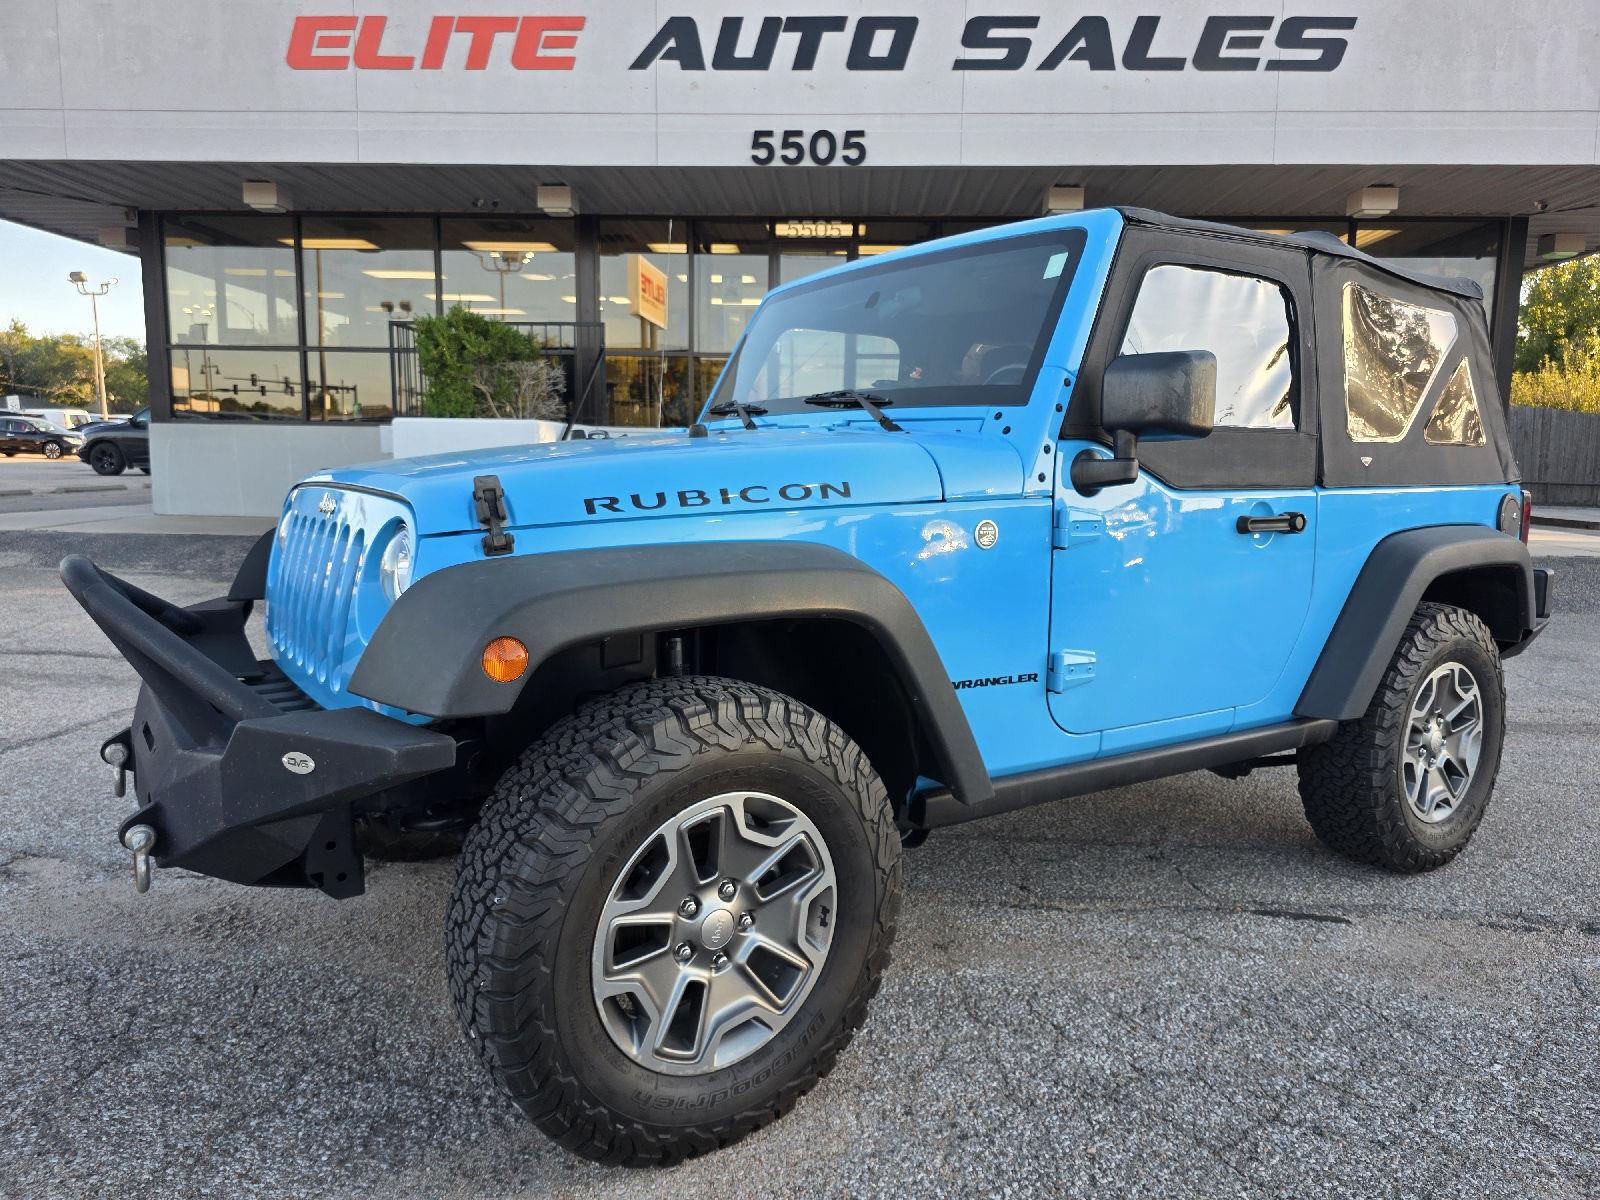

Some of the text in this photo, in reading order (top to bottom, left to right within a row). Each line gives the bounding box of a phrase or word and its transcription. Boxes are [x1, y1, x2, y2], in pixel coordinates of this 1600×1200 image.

[286, 15, 1358, 72] ELITE AUTO SALES
[751, 129, 867, 166] 5505
[787, 220, 842, 238] 5505
[583, 481, 852, 515] RUBICON
